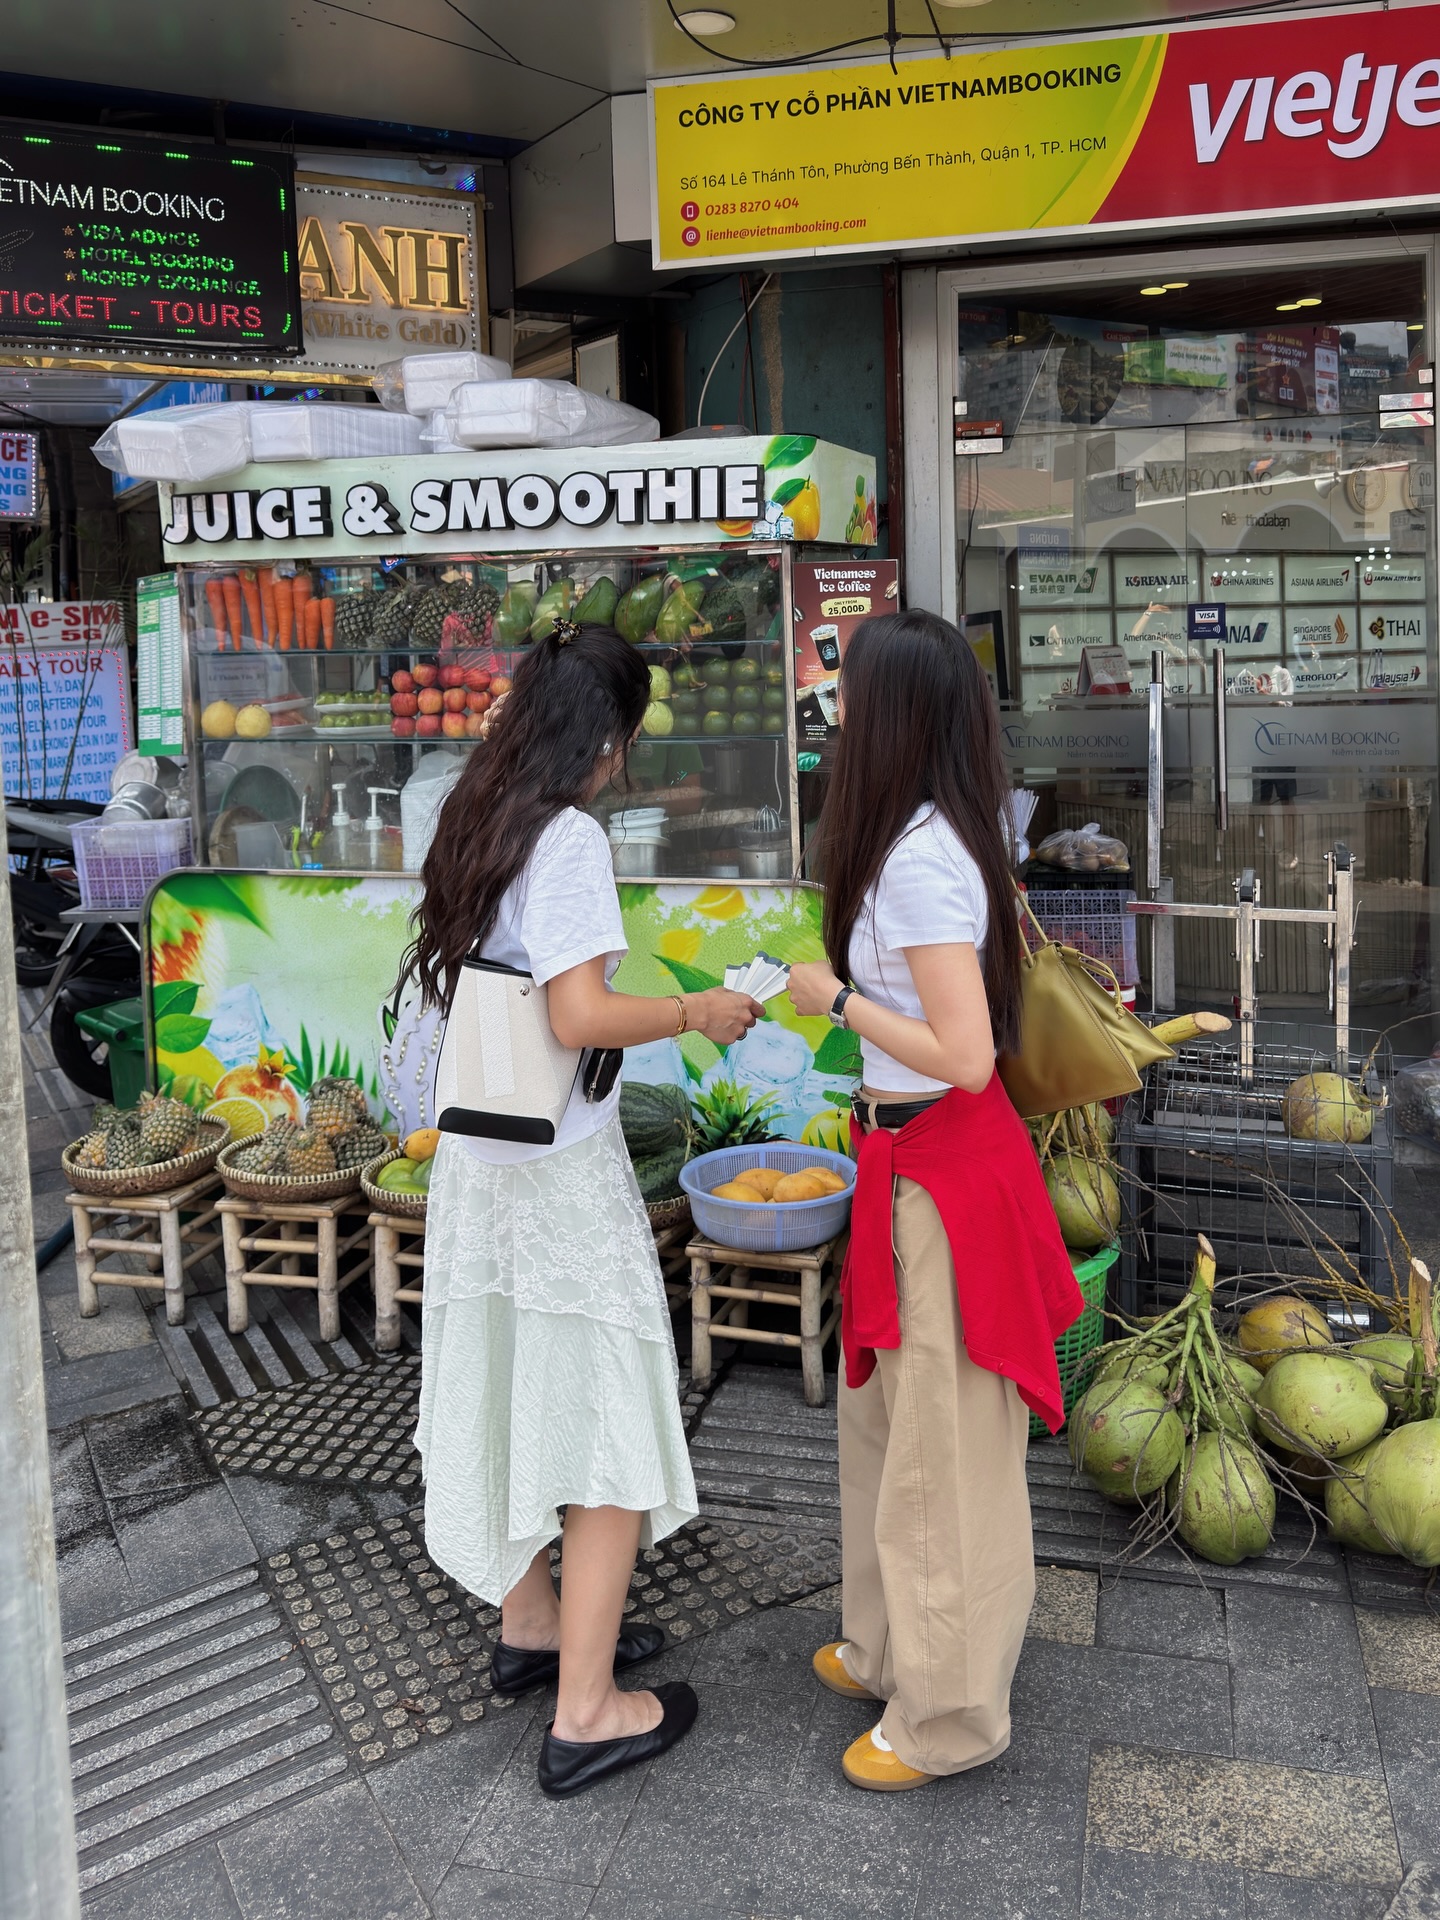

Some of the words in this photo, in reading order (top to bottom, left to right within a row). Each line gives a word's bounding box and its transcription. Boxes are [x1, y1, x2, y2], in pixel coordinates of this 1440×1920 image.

[678, 102, 744, 128] CÔNG
[750, 100, 780, 121] TY
[826, 85, 891, 113] PHẦN
[897, 63, 1122, 105] VIETNAMBOOKING
[680, 174, 698, 190] Số
[702, 174, 726, 188] 164
[731, 171, 747, 186] Lê
[752, 167, 795, 184] Thánh
[800, 165, 829, 180] Tôn,
[834, 159, 889, 176] Phường
[893, 154, 921, 170] Bến
[926, 149, 976, 167] Thành,
[980, 145, 1019, 163] Quận
[1024, 144, 1035, 159] 1,
[1040, 140, 1064, 155] TP.
[1069, 136, 1107, 152] HCM
[102, 187, 225, 222] BOOKING
[705, 202, 736, 217] 0283
[740, 199, 770, 213] 8270
[774, 197, 799, 209] 404
[78, 223, 125, 242] VISA
[129, 228, 201, 248] ADVICE
[706, 218, 867, 242] lienhe@vietnambooking.com
[80, 246, 146, 266] HOTEL
[150, 253, 235, 272] BOOKING
[81, 268, 151, 287] MONEY
[157, 274, 262, 296] EXCHANGE
[150, 299, 262, 329] TOURS
[303, 308, 391, 342] (White
[398, 315, 468, 348] Gold)
[162, 483, 332, 544] JUICE
[342, 482, 405, 536] &
[410, 463, 766, 533] SMOOTHIE
[813, 568, 877, 580] Vietnamese
[1169, 574, 1190, 585] AIR
[1222, 578, 1243, 587] CHINA
[1243, 577, 1274, 586] AIRLINES
[1291, 578, 1315, 587] ASIANA
[1315, 577, 1343, 587] AIRLINES
[819, 581, 836, 593] Ice
[837, 580, 871, 592] Coffee
[31, 605, 121, 628] e-SIM
[828, 604, 865, 616] 25,000Đ
[61, 629, 102, 641] 5G
[1293, 625, 1332, 634] SINGAPORE
[1386, 619, 1421, 636] THAI
[1123, 632, 1156, 642] American
[1301, 633, 1332, 641] AIRLINES
[47, 657, 104, 675] TOUR
[1295, 673, 1336, 682] AEROFLOT
[43, 694, 103, 711] AFTERNON)
[24, 718, 51, 733] DELA
[1067, 735, 1129, 748] BOOKING
[1332, 731, 1400, 746] BOOKING
